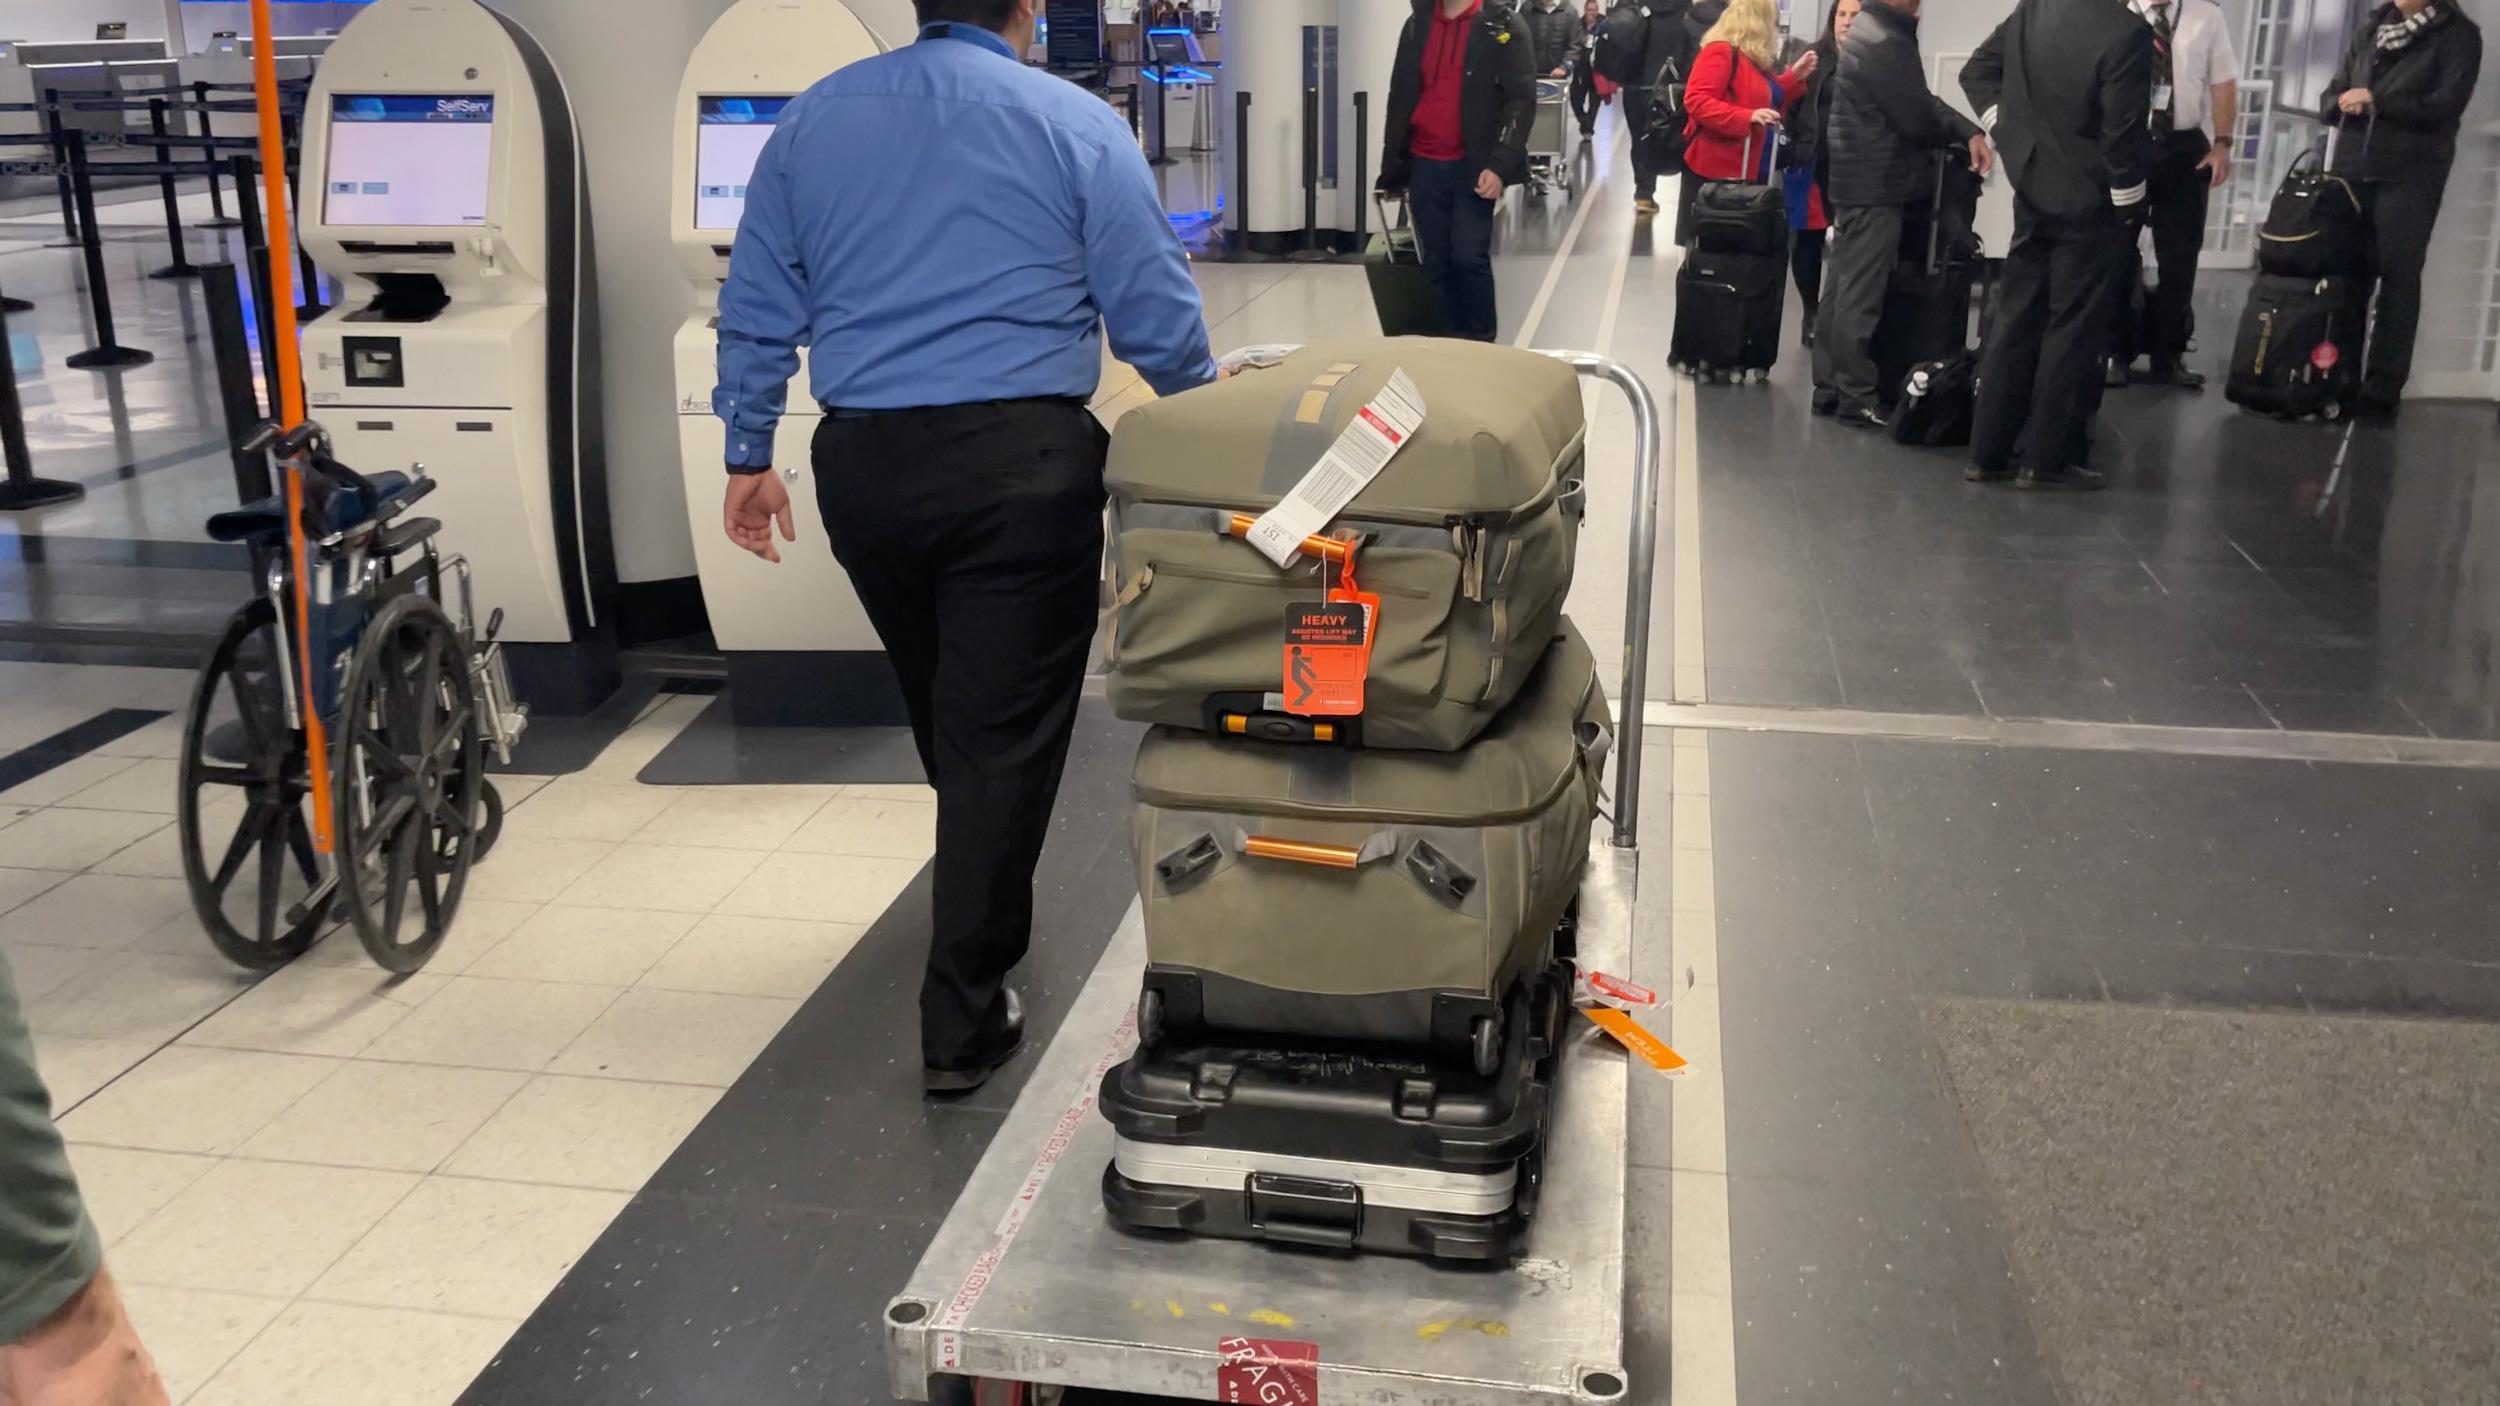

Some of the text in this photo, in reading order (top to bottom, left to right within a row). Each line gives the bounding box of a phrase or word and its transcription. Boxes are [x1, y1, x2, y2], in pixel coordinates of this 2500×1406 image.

[436, 99, 489, 112] SelfServ
[1301, 615, 1347, 625] HEAVY
[1292, 1382, 1309, 1403] CARE
